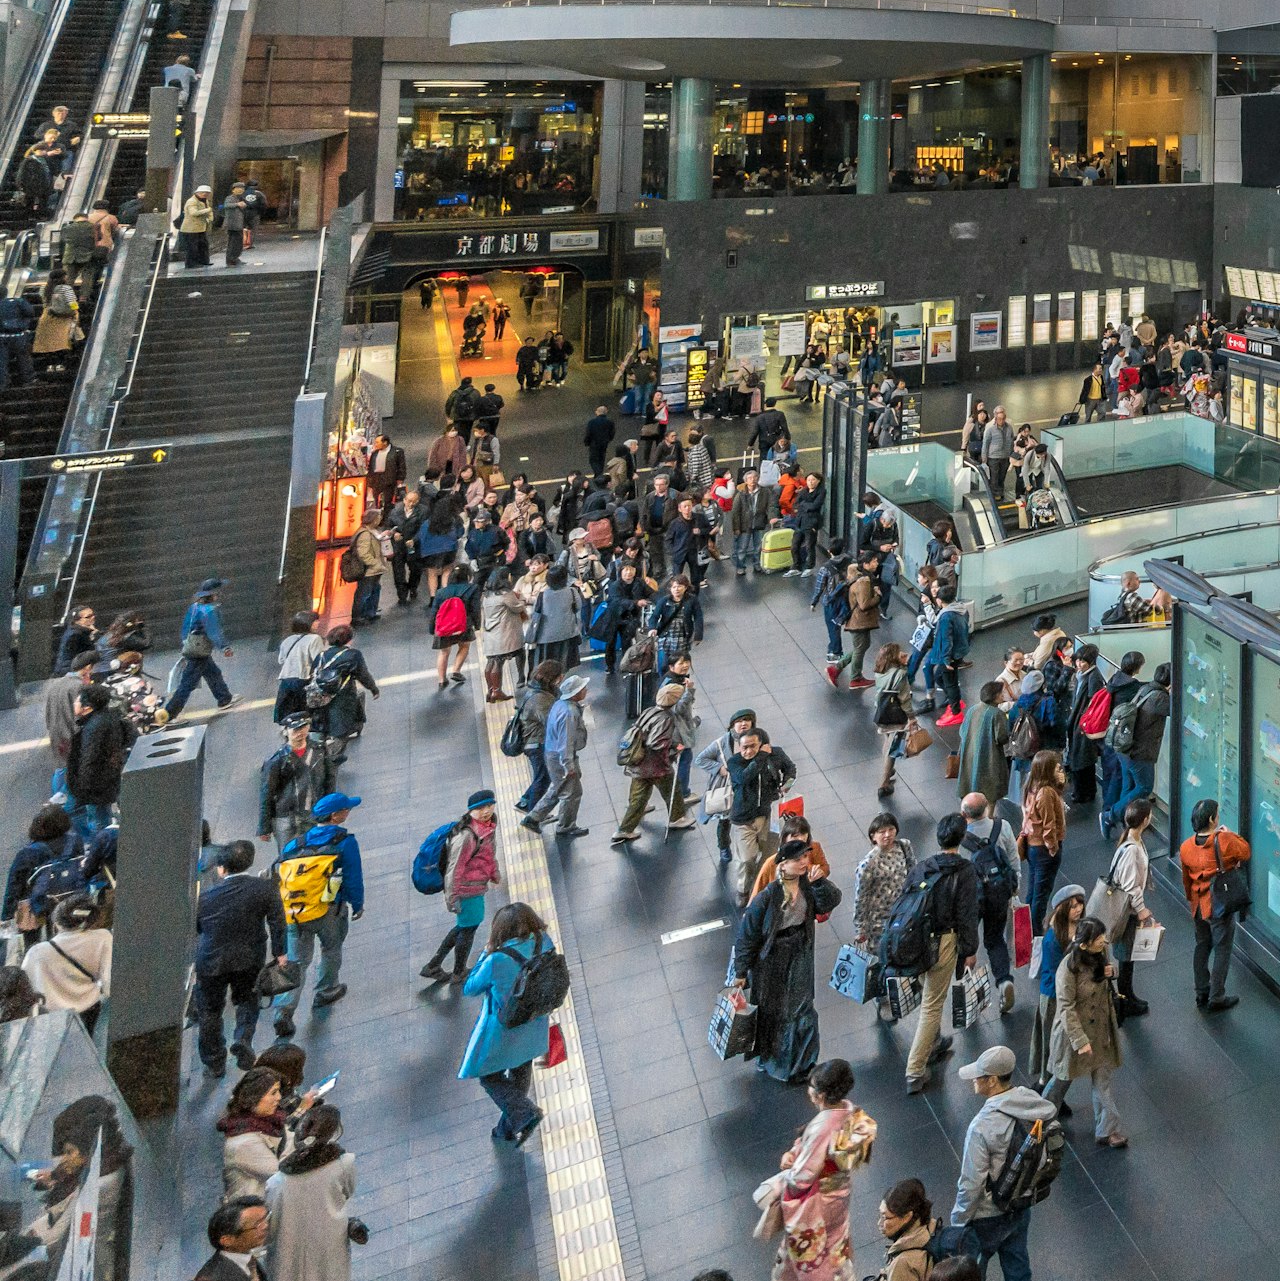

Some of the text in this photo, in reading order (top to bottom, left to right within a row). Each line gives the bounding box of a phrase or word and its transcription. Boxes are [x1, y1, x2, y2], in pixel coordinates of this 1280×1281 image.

[456, 232, 540, 256] 京都劇場
[828, 283, 878, 293] きっぷうりば
